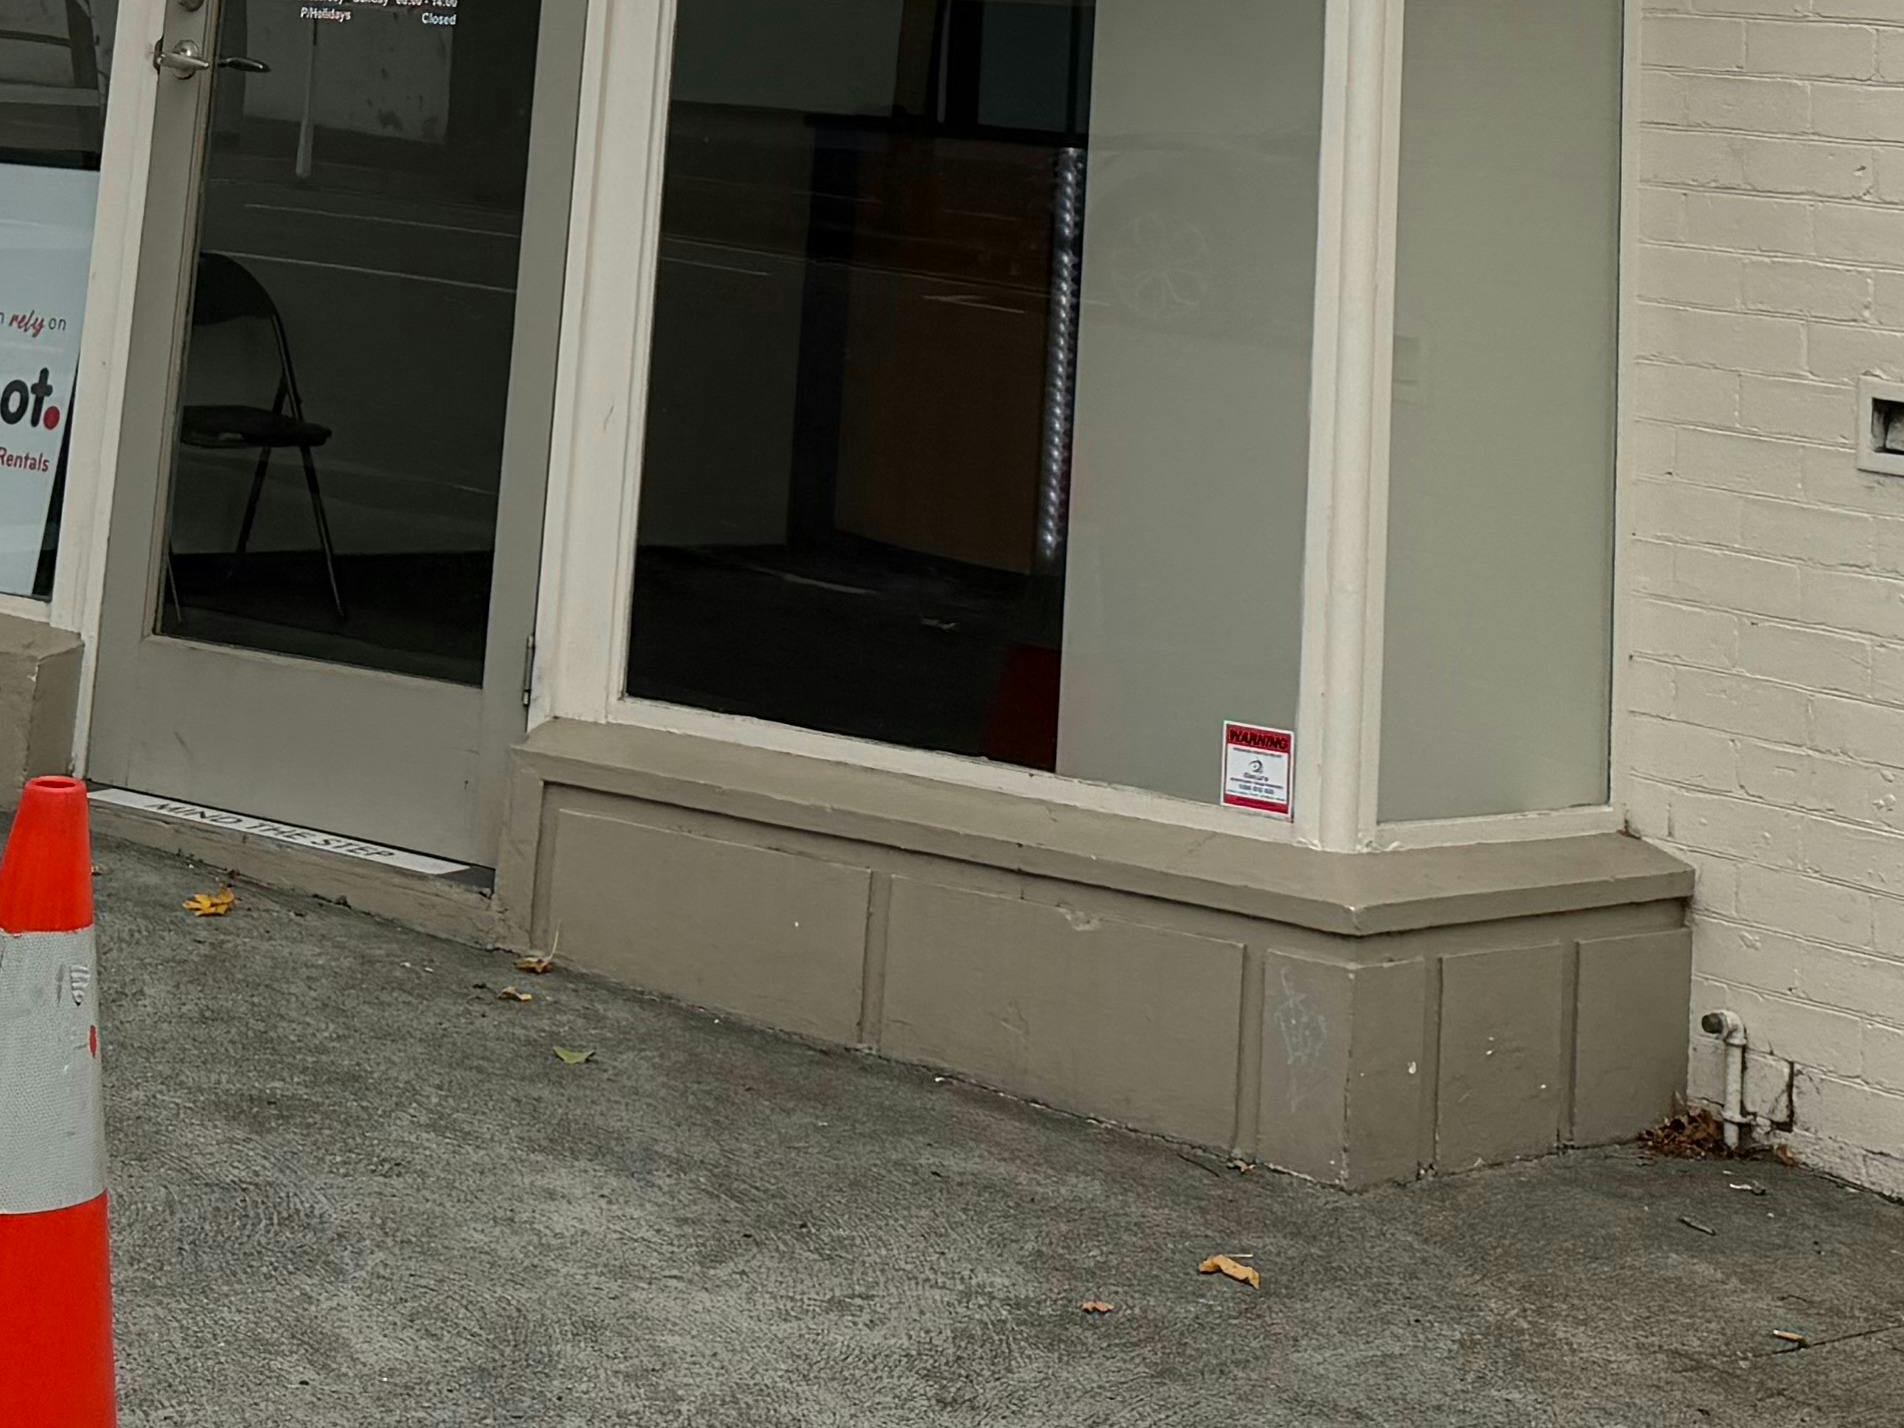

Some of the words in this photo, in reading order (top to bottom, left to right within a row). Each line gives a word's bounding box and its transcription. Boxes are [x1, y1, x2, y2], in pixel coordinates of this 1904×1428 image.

[421, 12, 456, 25] Closed
[8, 310, 46, 338] rely
[48, 317, 67, 331] on
[1229, 729, 1287, 750] WARNING
[146, 800, 243, 825] MIND
[245, 821, 307, 841] THE
[310, 835, 396, 860] STEP
